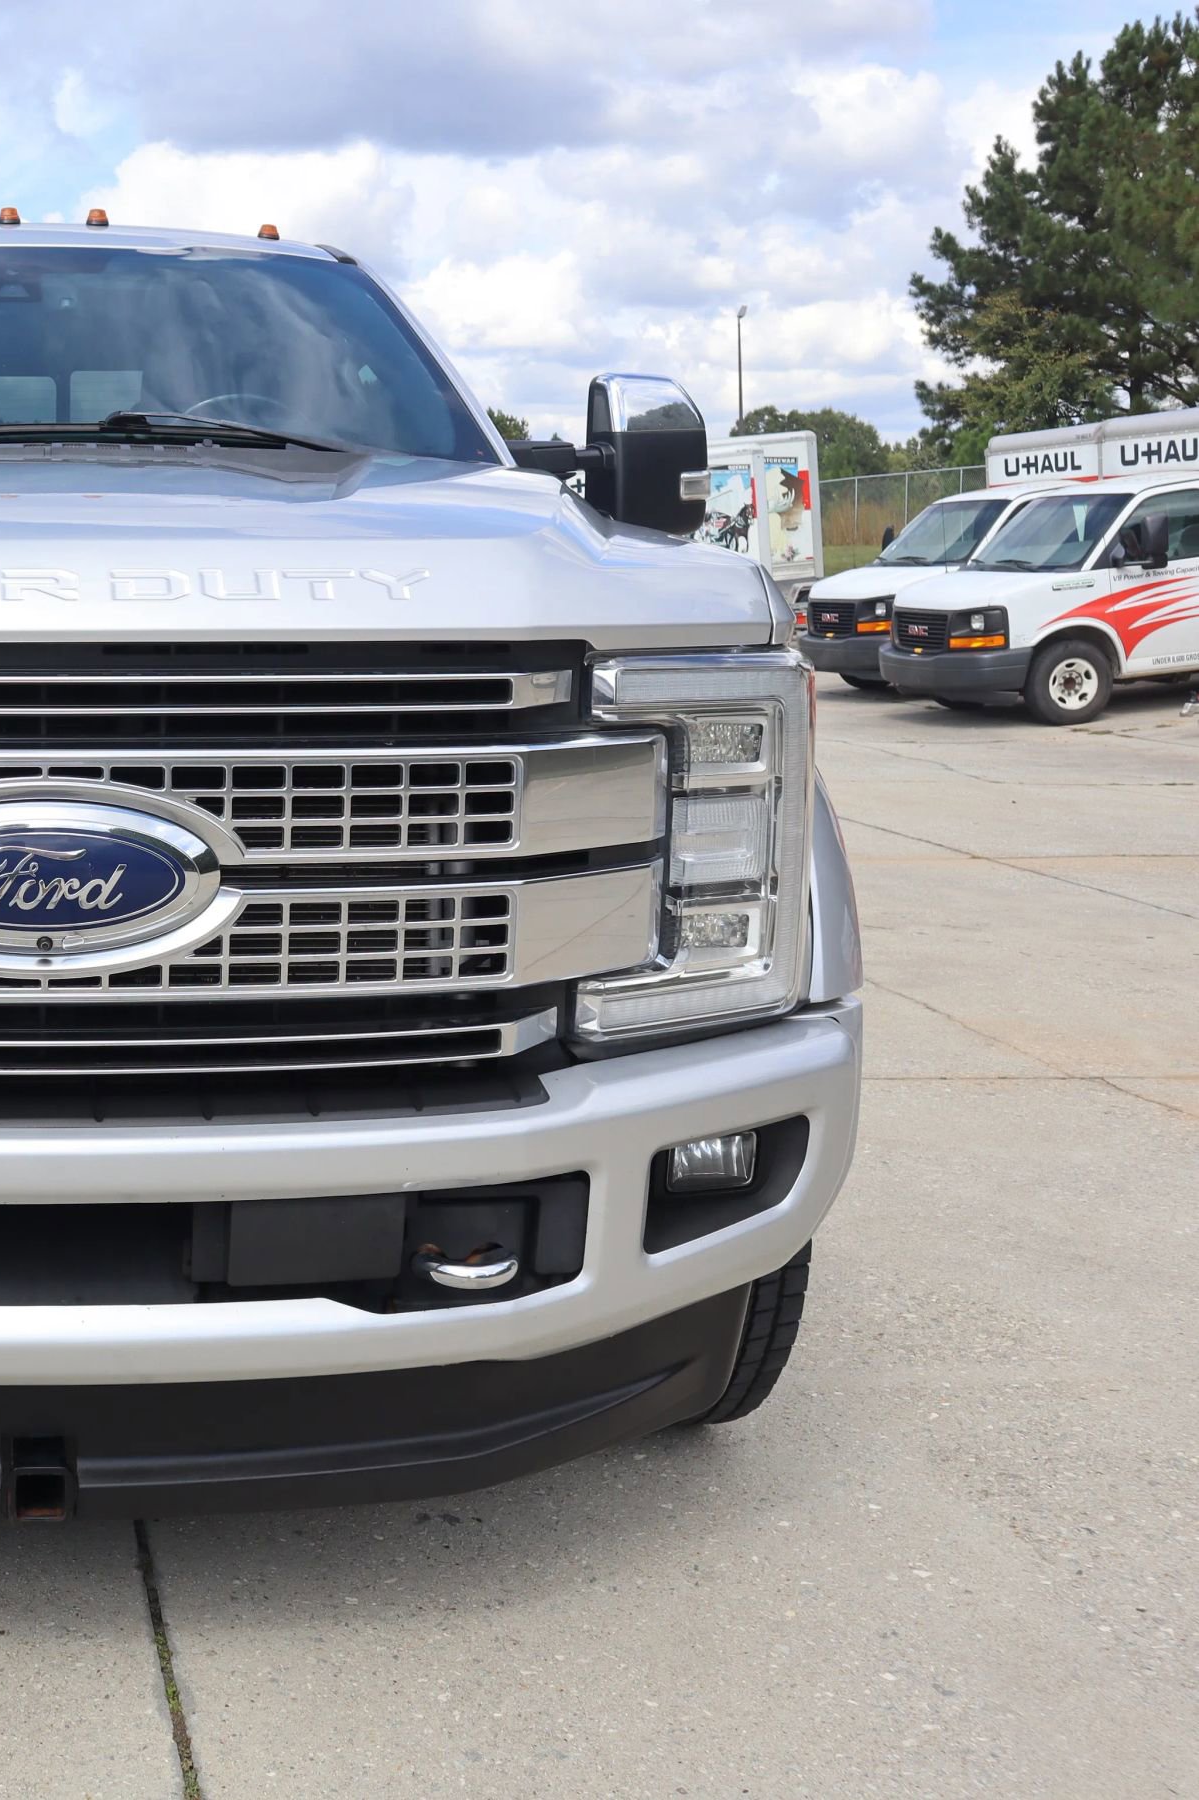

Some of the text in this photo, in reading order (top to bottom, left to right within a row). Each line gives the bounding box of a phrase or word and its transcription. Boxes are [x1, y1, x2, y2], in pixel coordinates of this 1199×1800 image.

[1004, 451, 1082, 477] U-HAUL
[1152, 568, 1175, 578] Towing
[110, 567, 431, 601] DUTY
[821, 612, 839, 623] GMC
[908, 625, 929, 637] GMC
[1152, 655, 1171, 665] UNDER
